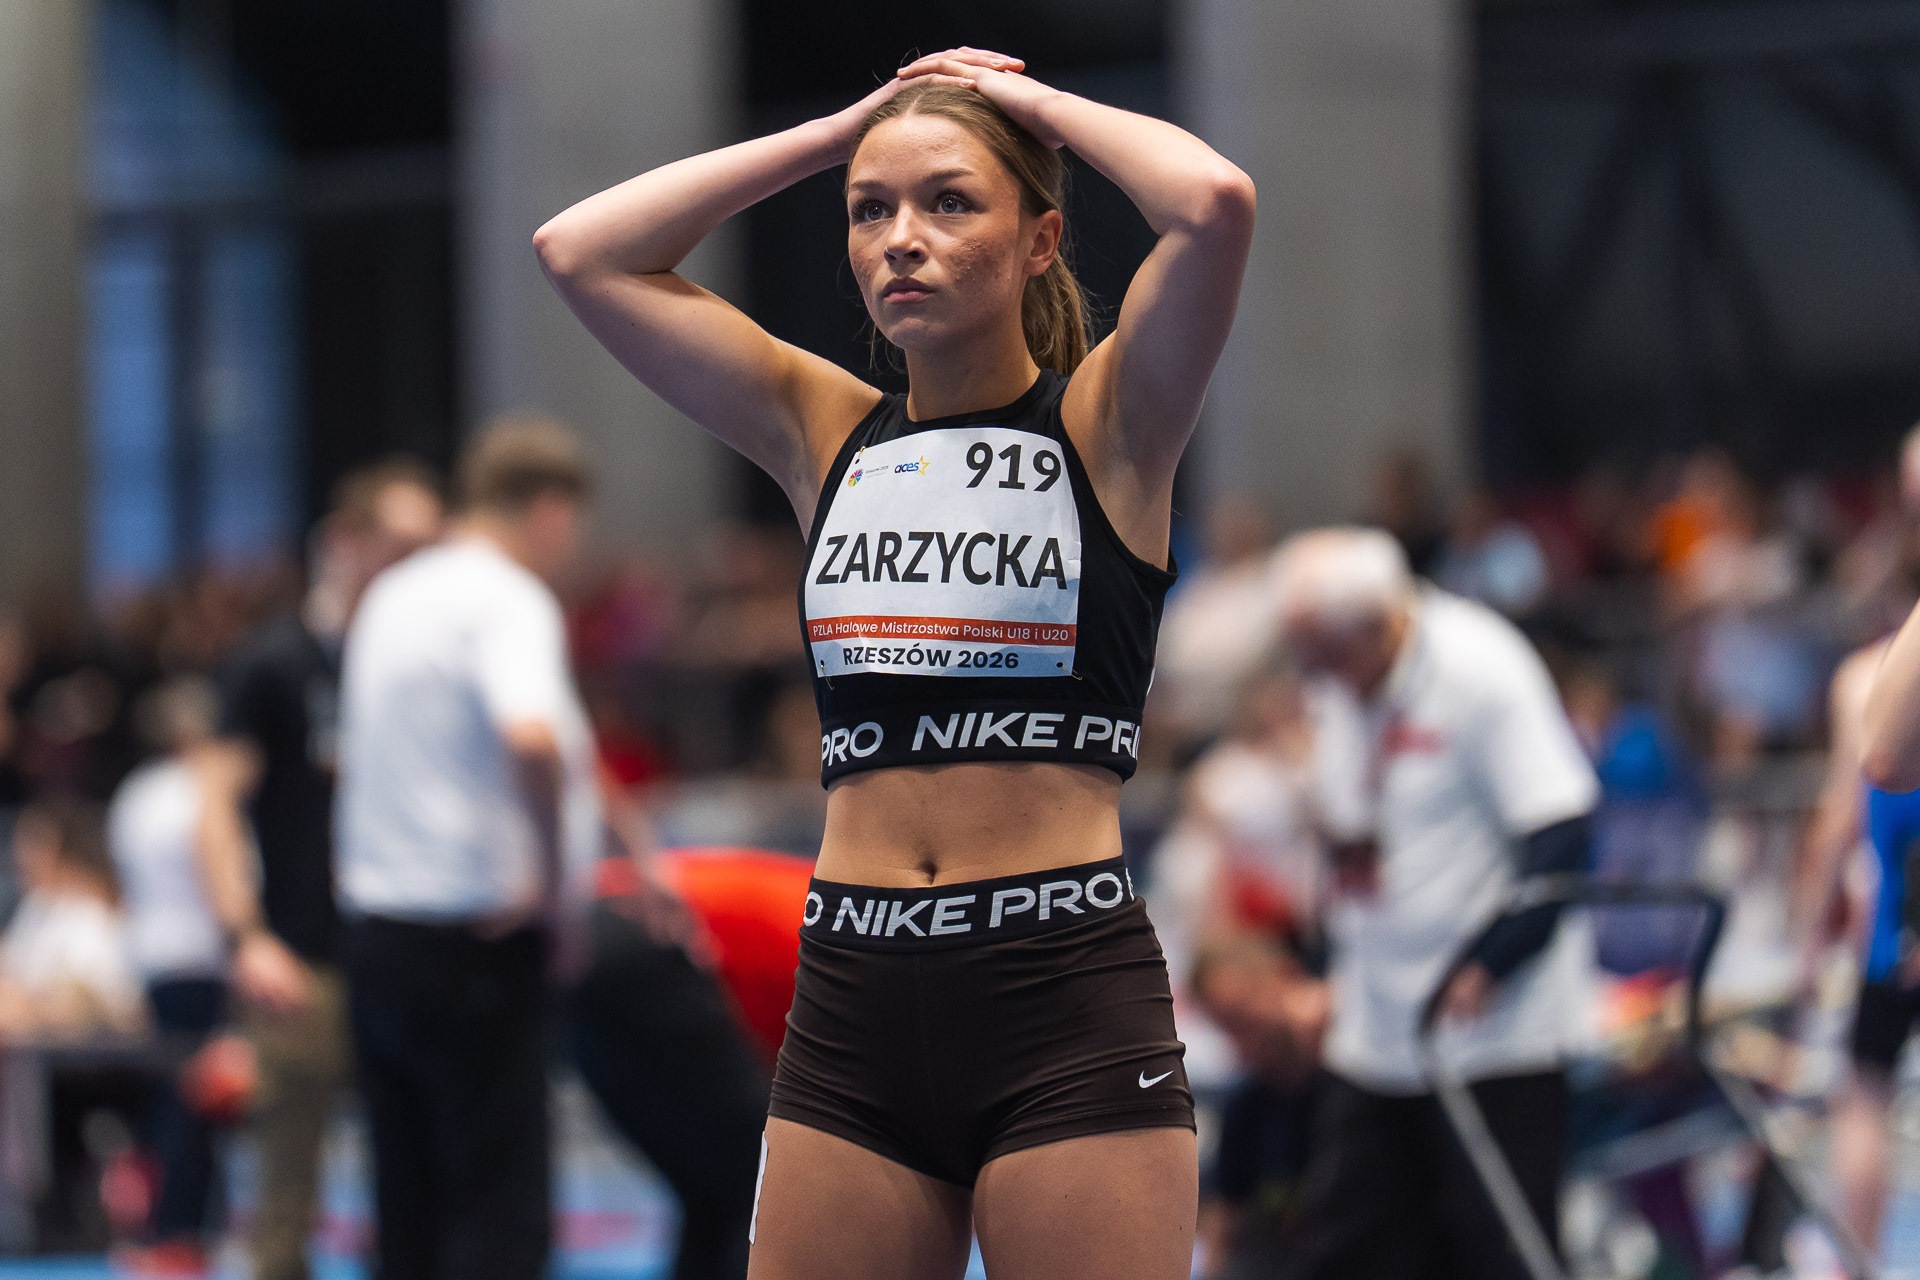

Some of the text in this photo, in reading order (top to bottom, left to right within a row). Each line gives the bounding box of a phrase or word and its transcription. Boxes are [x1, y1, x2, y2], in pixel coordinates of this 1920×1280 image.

[894, 462, 919, 474] aces
[965, 441, 1062, 492] 919
[815, 531, 1067, 590] ZARZYCKA
[813, 621, 1069, 641] PZLA Halowe Mistrzostwa Polski U18 i U20
[843, 642, 1019, 669] RZESZÓW 2026
[821, 711, 1140, 767] PRO NIKE PR
[831, 893, 977, 938] NIKE
[989, 872, 1124, 930] PRO
